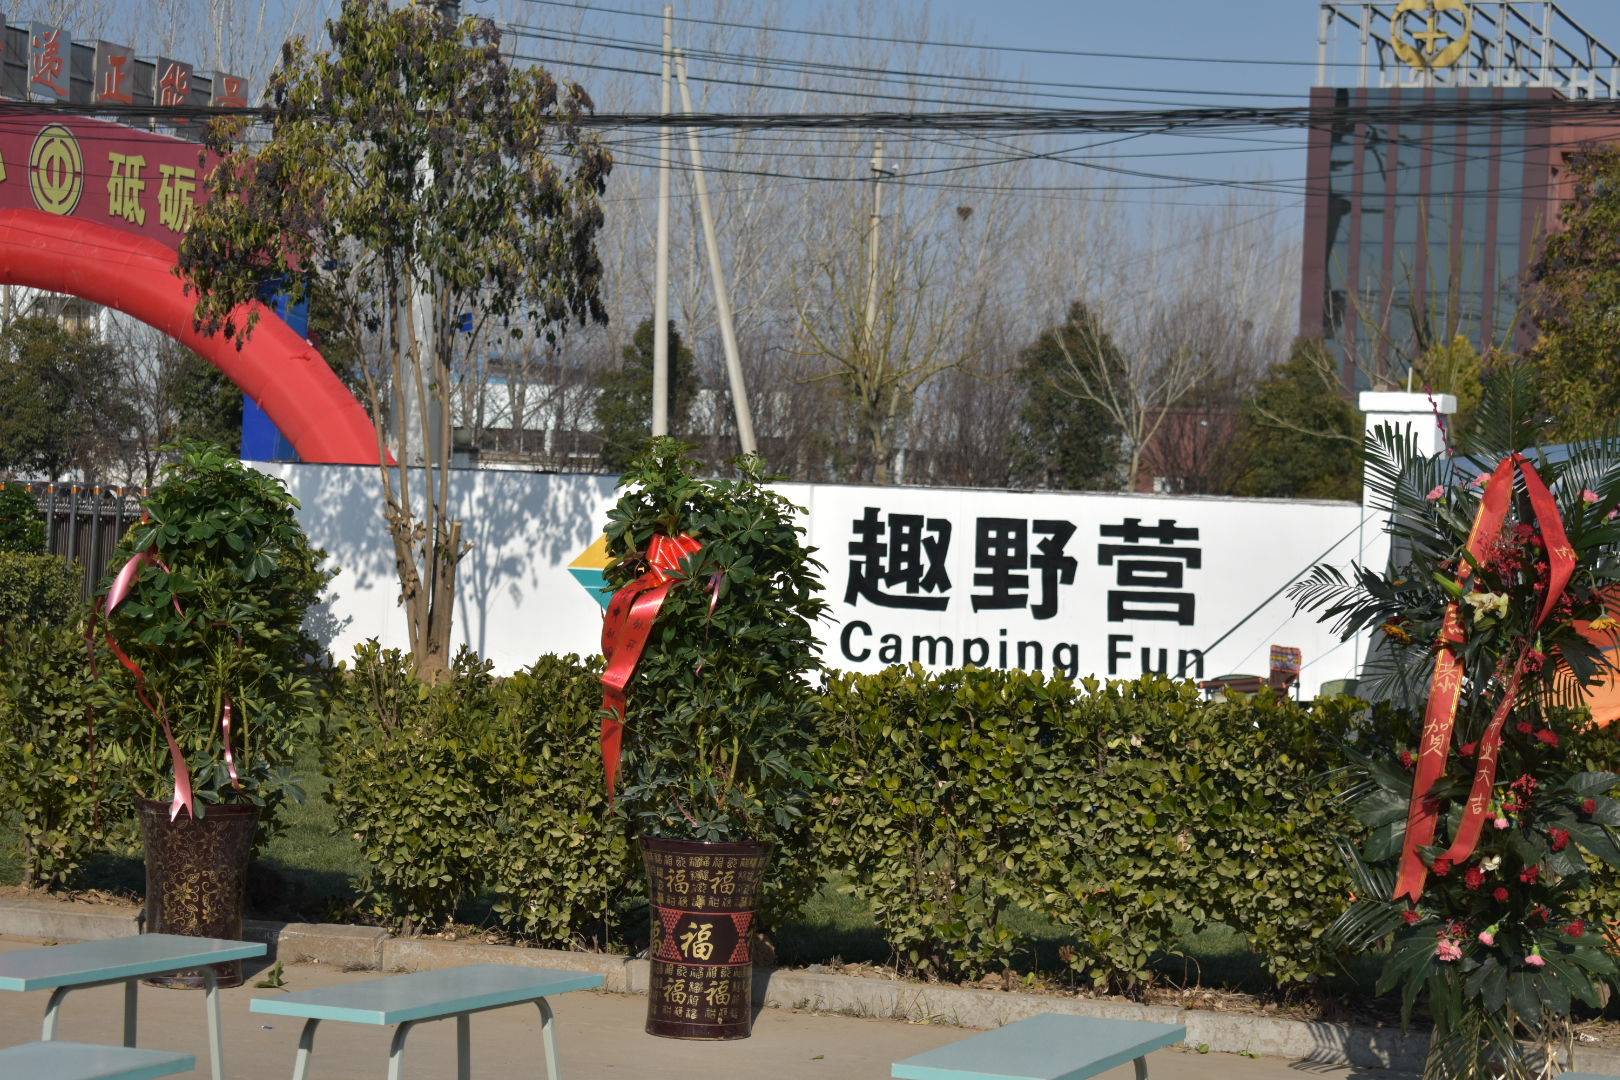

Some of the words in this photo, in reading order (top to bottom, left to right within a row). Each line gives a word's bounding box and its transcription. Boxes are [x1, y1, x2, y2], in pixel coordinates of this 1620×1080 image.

[107, 152, 197, 233] 砥砺
[843, 507, 1202, 626] 趣野营
[840, 620, 1080, 681] Camping
[1108, 634, 1205, 679] Fun
[664, 868, 689, 894] 福
[710, 869, 736, 895] 福
[680, 921, 714, 960] 福
[663, 977, 687, 1005] 福
[704, 980, 731, 1006] 福
